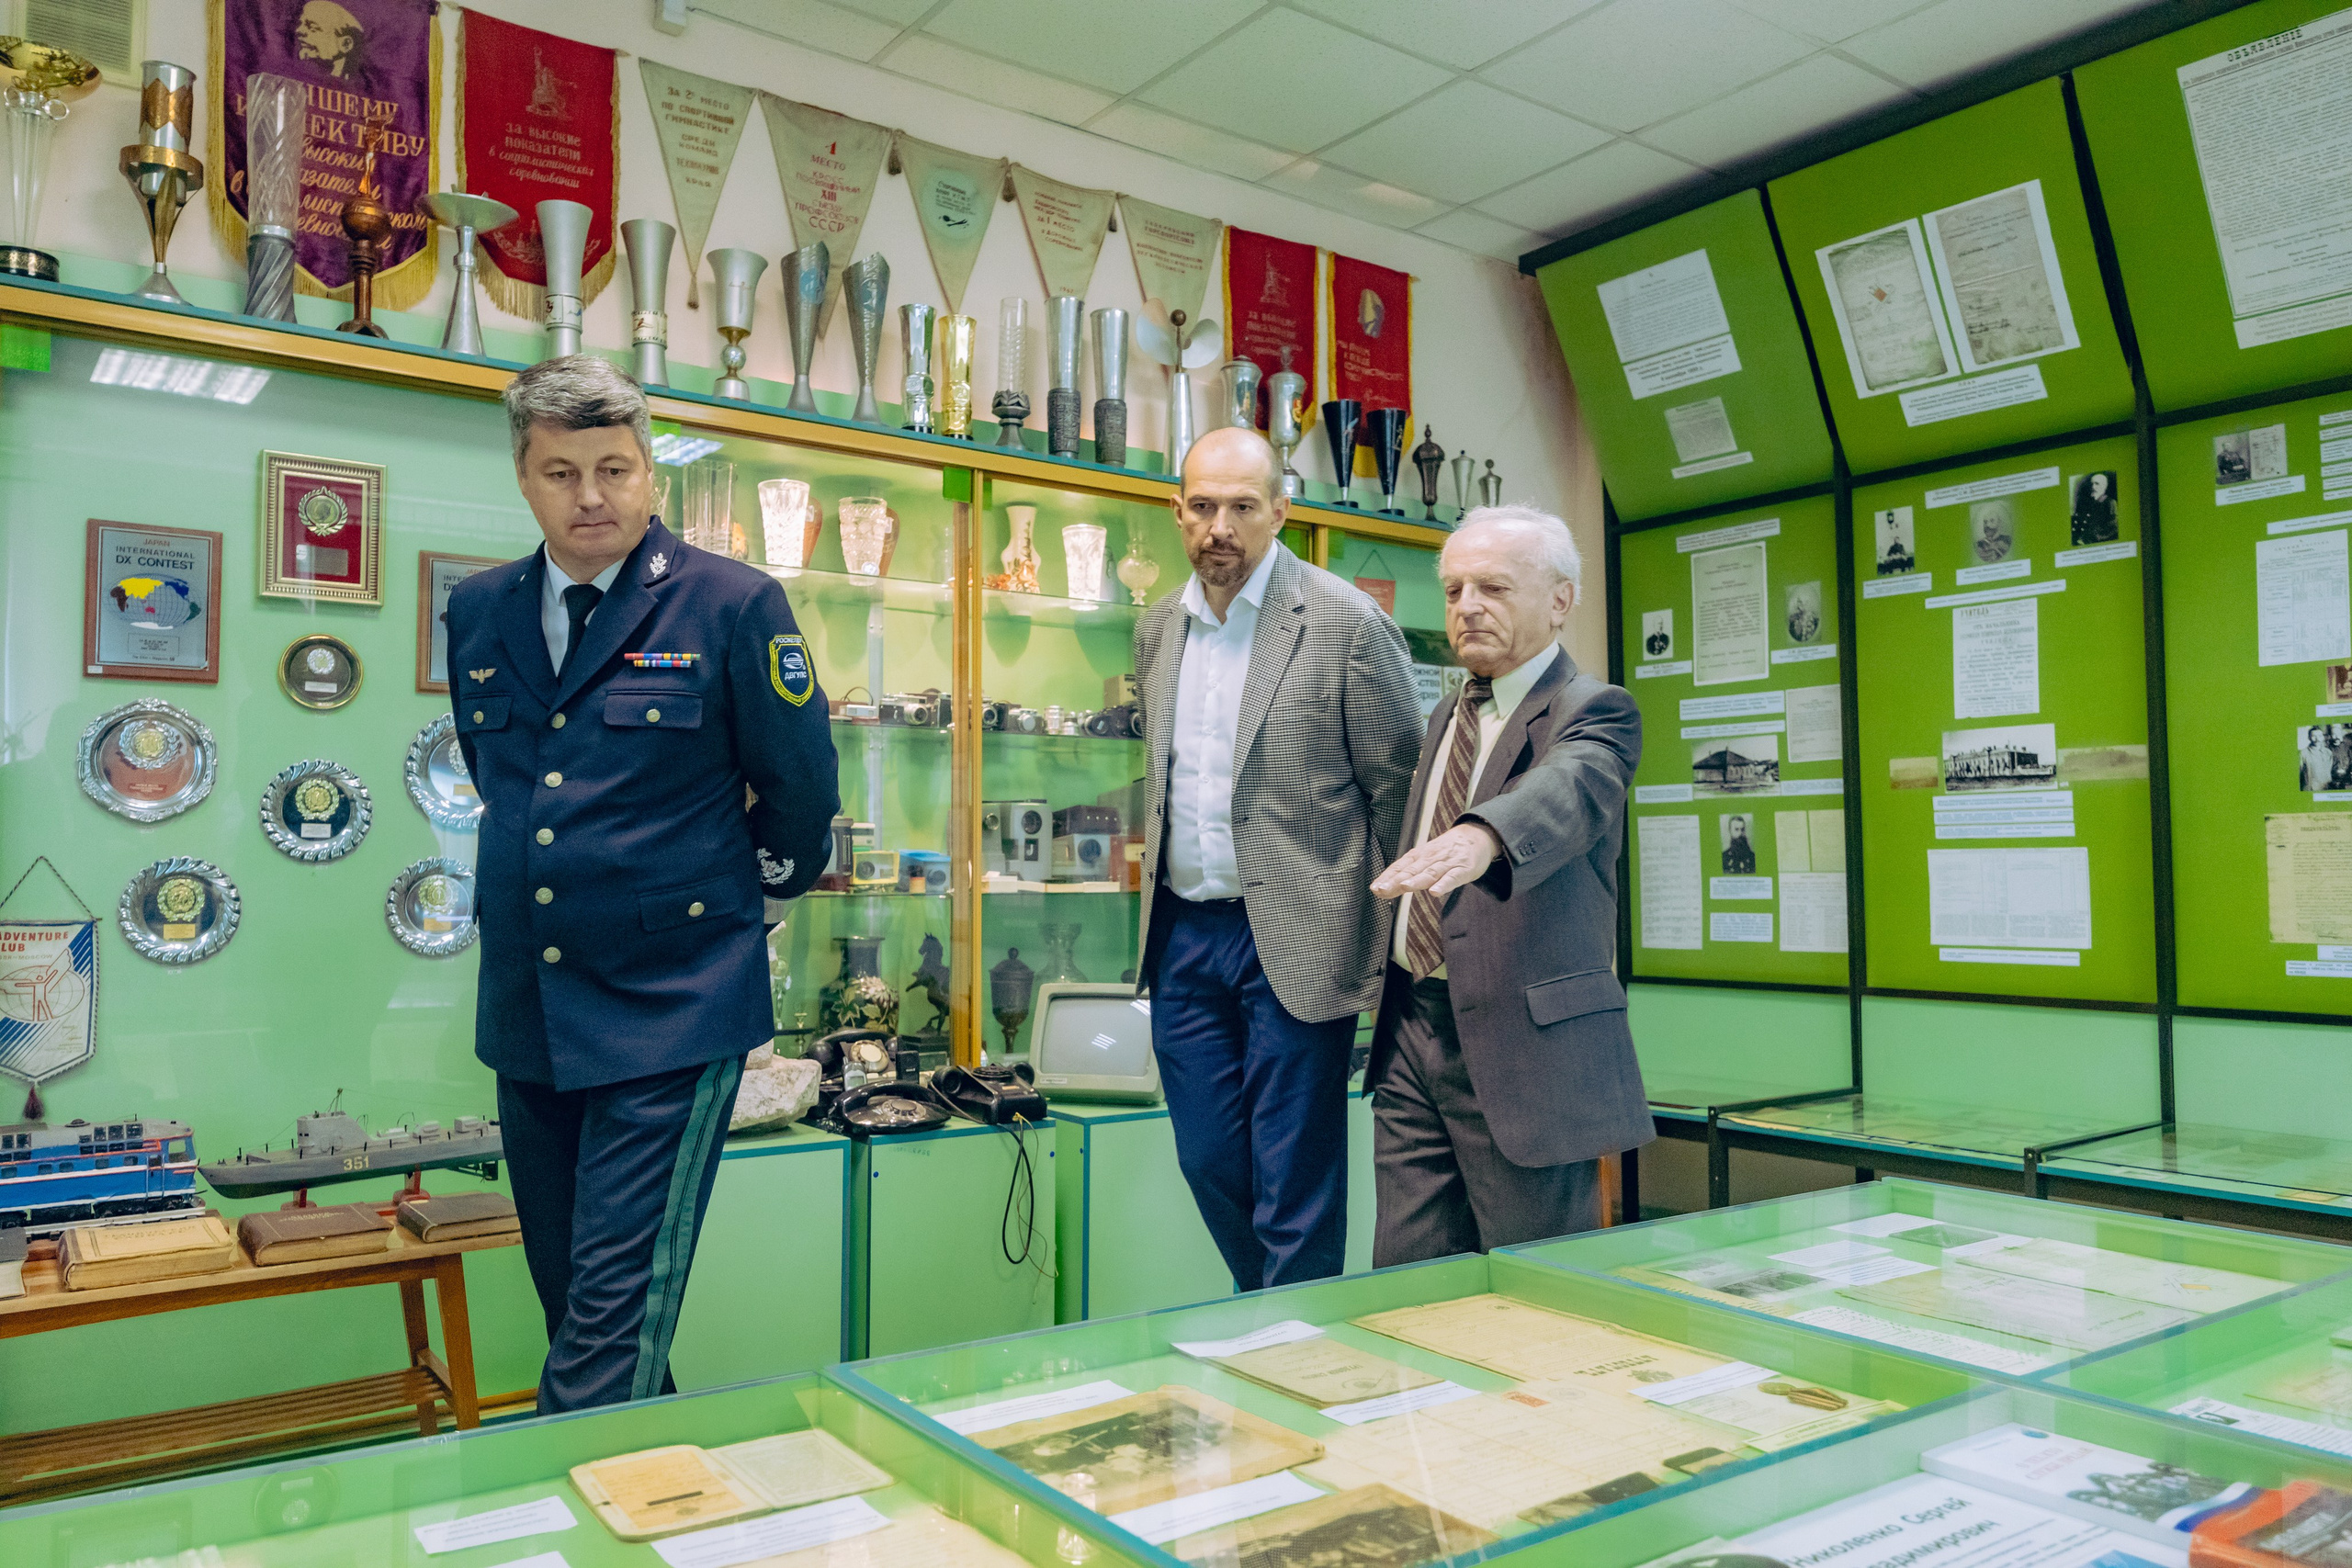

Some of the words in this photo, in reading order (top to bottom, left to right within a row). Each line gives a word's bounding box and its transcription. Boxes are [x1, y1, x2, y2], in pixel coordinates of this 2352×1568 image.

[665, 114, 729, 134] ГИМНАСТИКЕ
[504, 136, 581, 162] показатели
[825, 141, 837, 155] 1
[810, 154, 846, 171] МЕСТО
[808, 216, 845, 232] СССР
[143, 538, 170, 547] JAPAN
[115, 546, 195, 559] INTERNATIONAL
[115, 555, 131, 564] DX
[137, 556, 195, 570] CONTEST
[784, 671, 808, 681] ДВГУПС
[1, 942, 26, 953] LUB
[1785, 1524, 1903, 1568] Николенко
[1900, 1496, 1973, 1527] Сергей
[1868, 1519, 2001, 1568] адимирович
